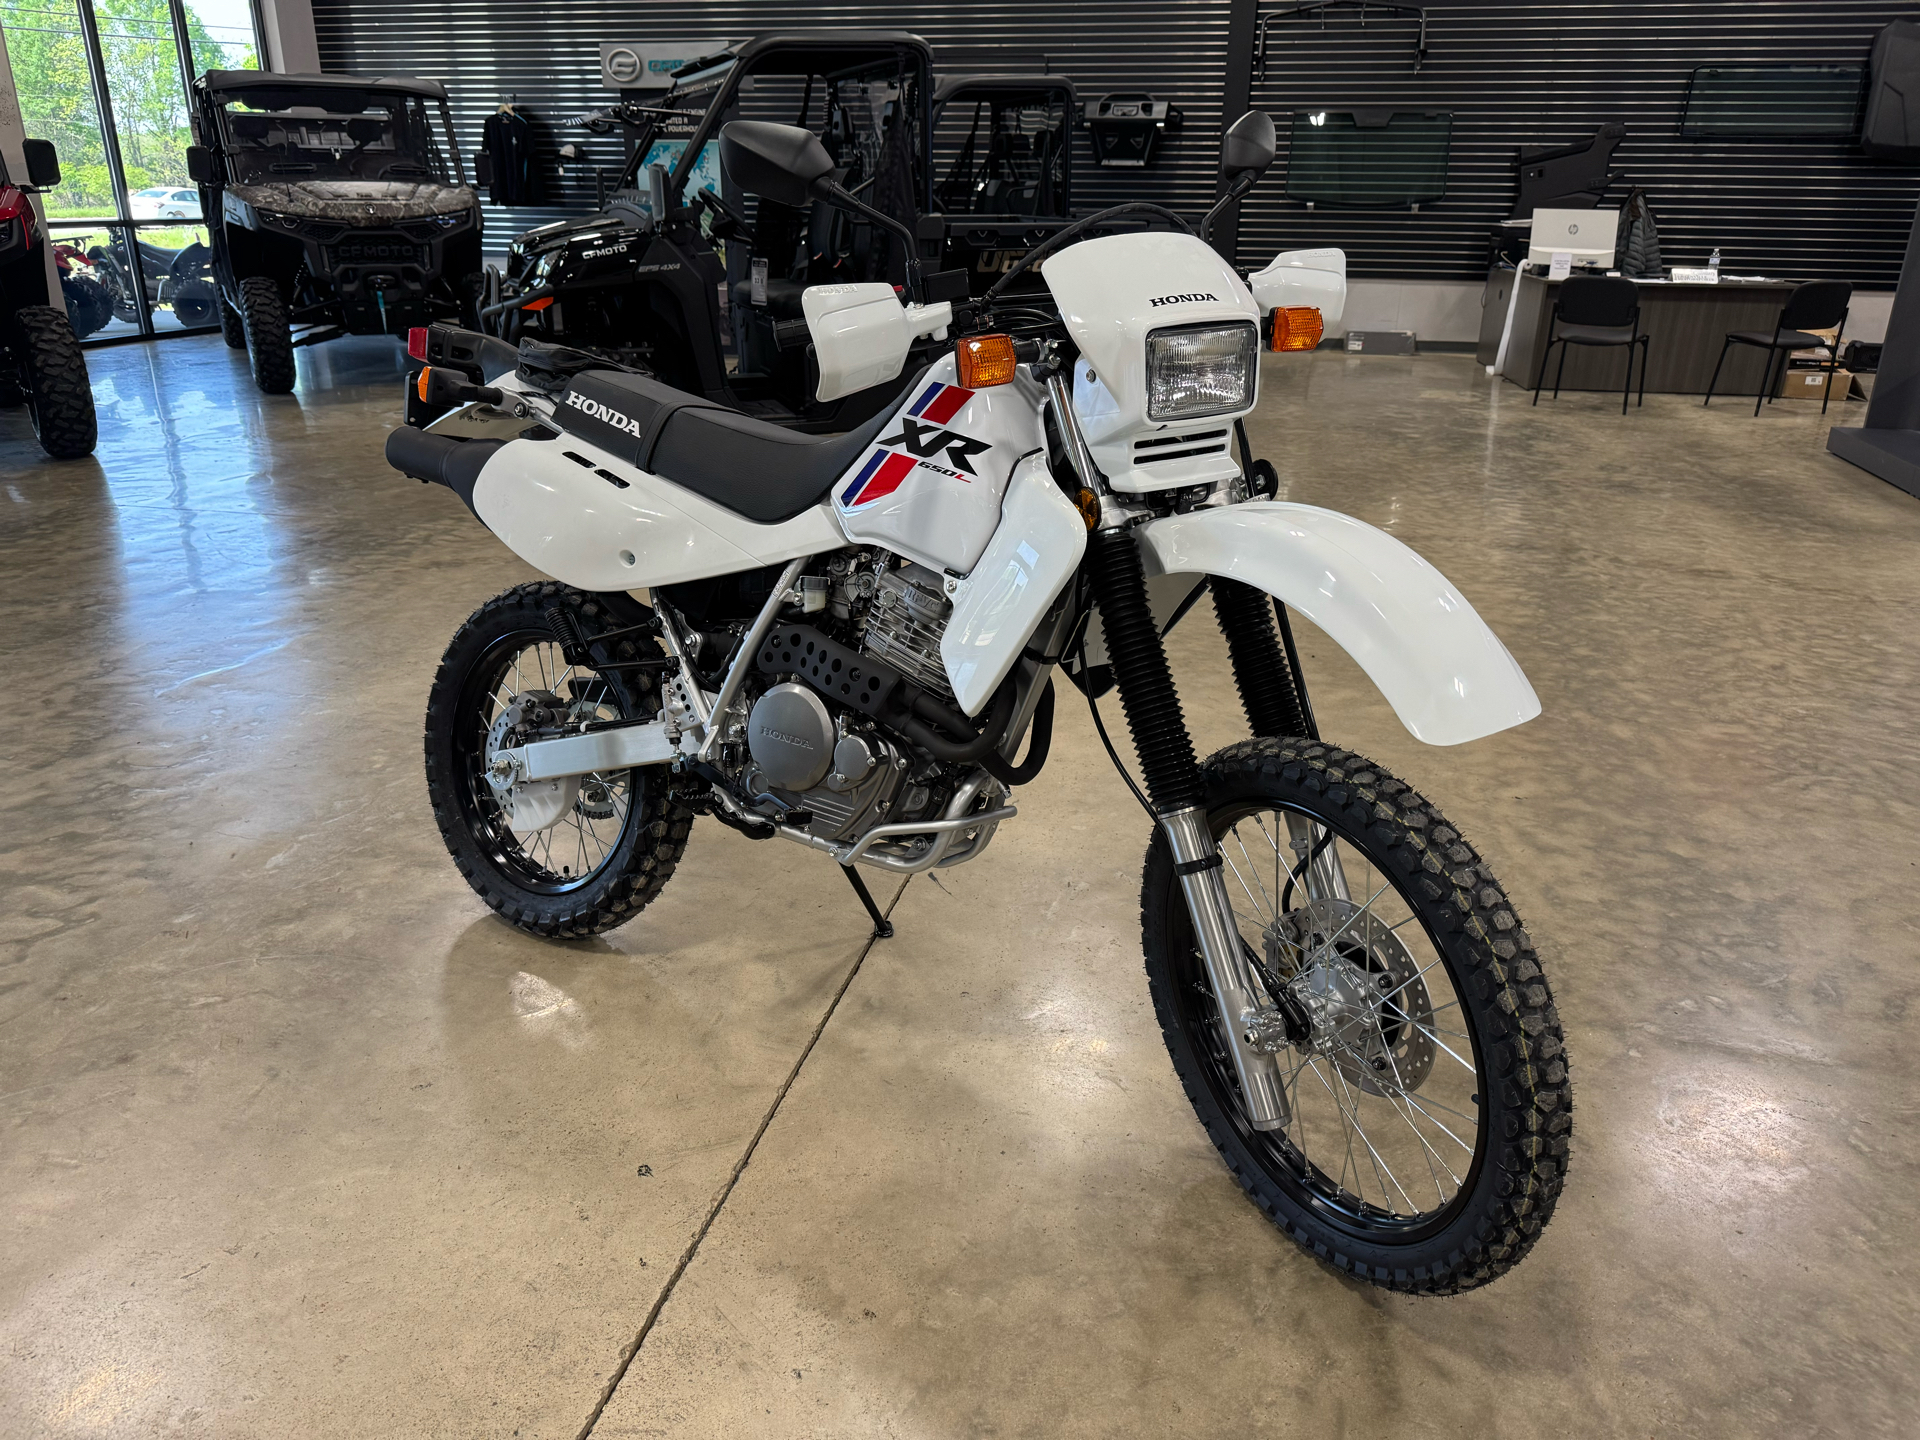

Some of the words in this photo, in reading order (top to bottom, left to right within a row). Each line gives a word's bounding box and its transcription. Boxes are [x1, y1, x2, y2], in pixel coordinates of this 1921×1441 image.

[338, 245, 414, 257] CFMOTO
[582, 244, 628, 259] CFMOTO
[638, 264, 660, 273] EPS
[660, 263, 681, 271] 4X4
[818, 284, 858, 296] HONDA
[1149, 293, 1219, 307] HONDA
[565, 390, 641, 438] HONDA
[875, 417, 993, 477] XR
[918, 461, 972, 483] 650L
[760, 725, 814, 750] HONDA
